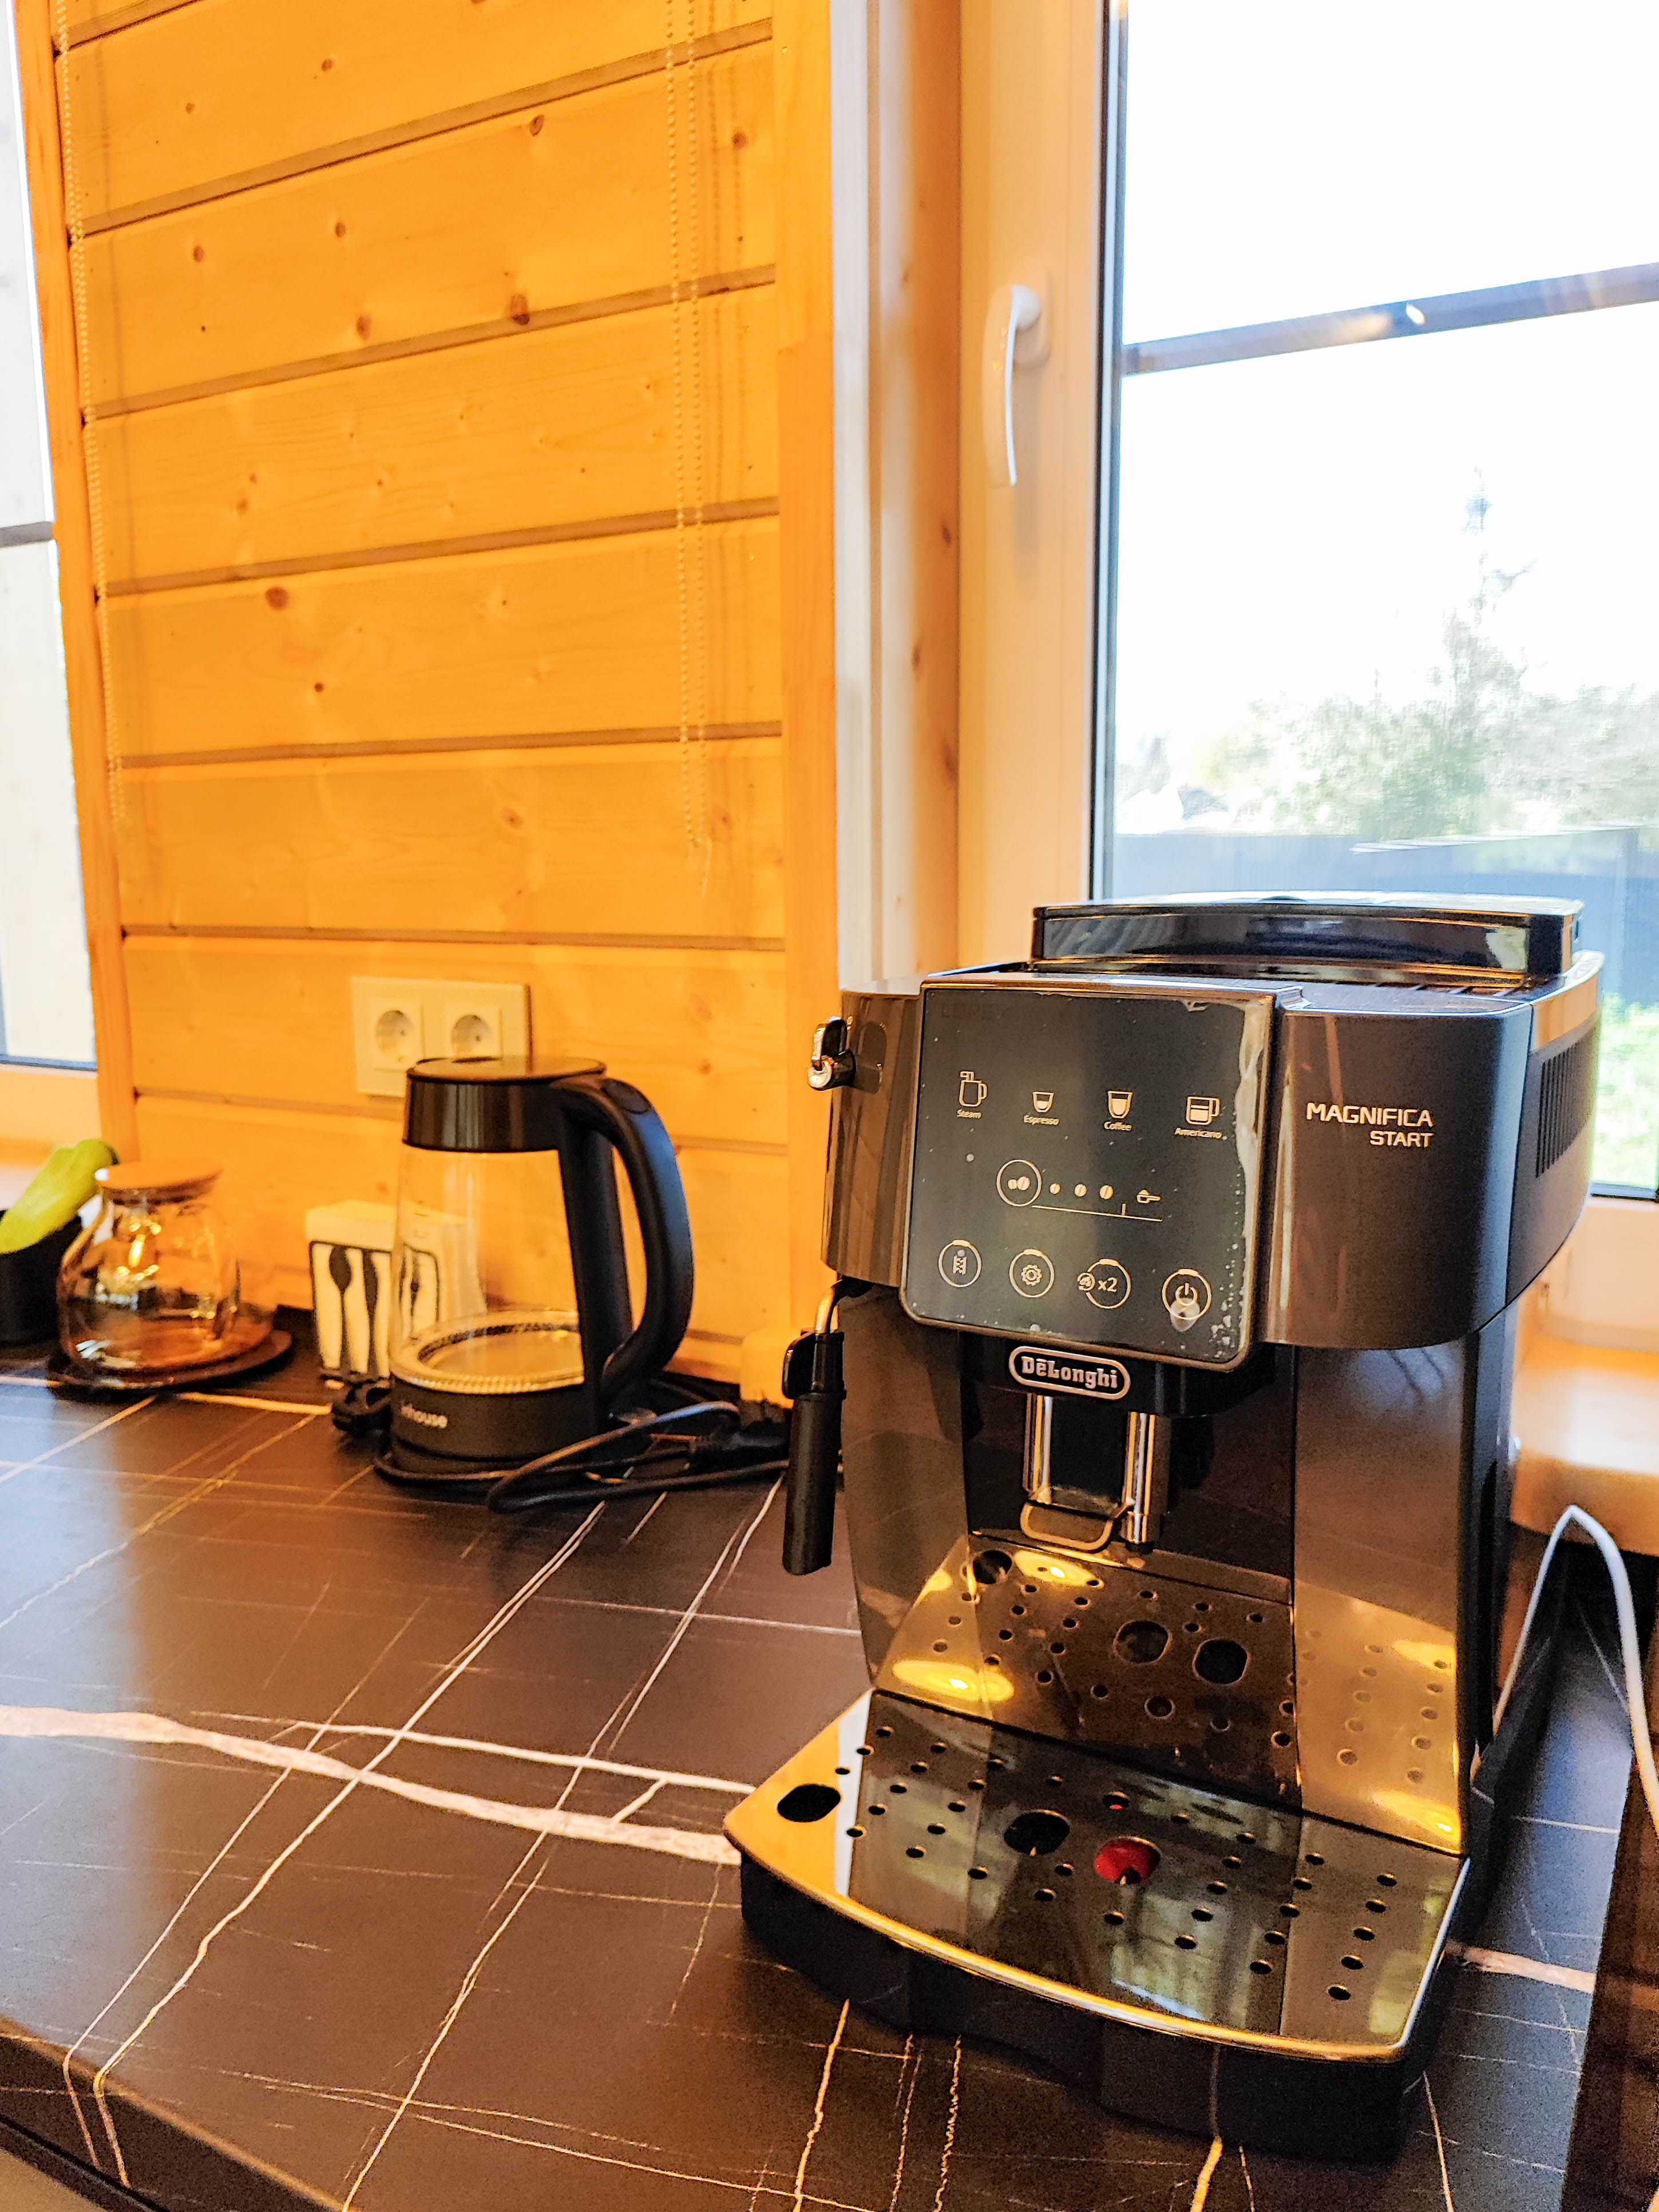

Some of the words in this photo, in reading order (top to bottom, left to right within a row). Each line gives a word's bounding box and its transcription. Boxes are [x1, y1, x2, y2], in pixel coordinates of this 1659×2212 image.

[957, 1109, 982, 1119] Steam
[1306, 1102, 1434, 1127] MAGNIFICA
[1023, 1115, 1060, 1126] Espresso
[1104, 1121, 1133, 1131] Coffee
[1174, 1127, 1223, 1139] Americano
[1369, 1130, 1434, 1147] START
[1098, 1277, 1118, 1292] x2
